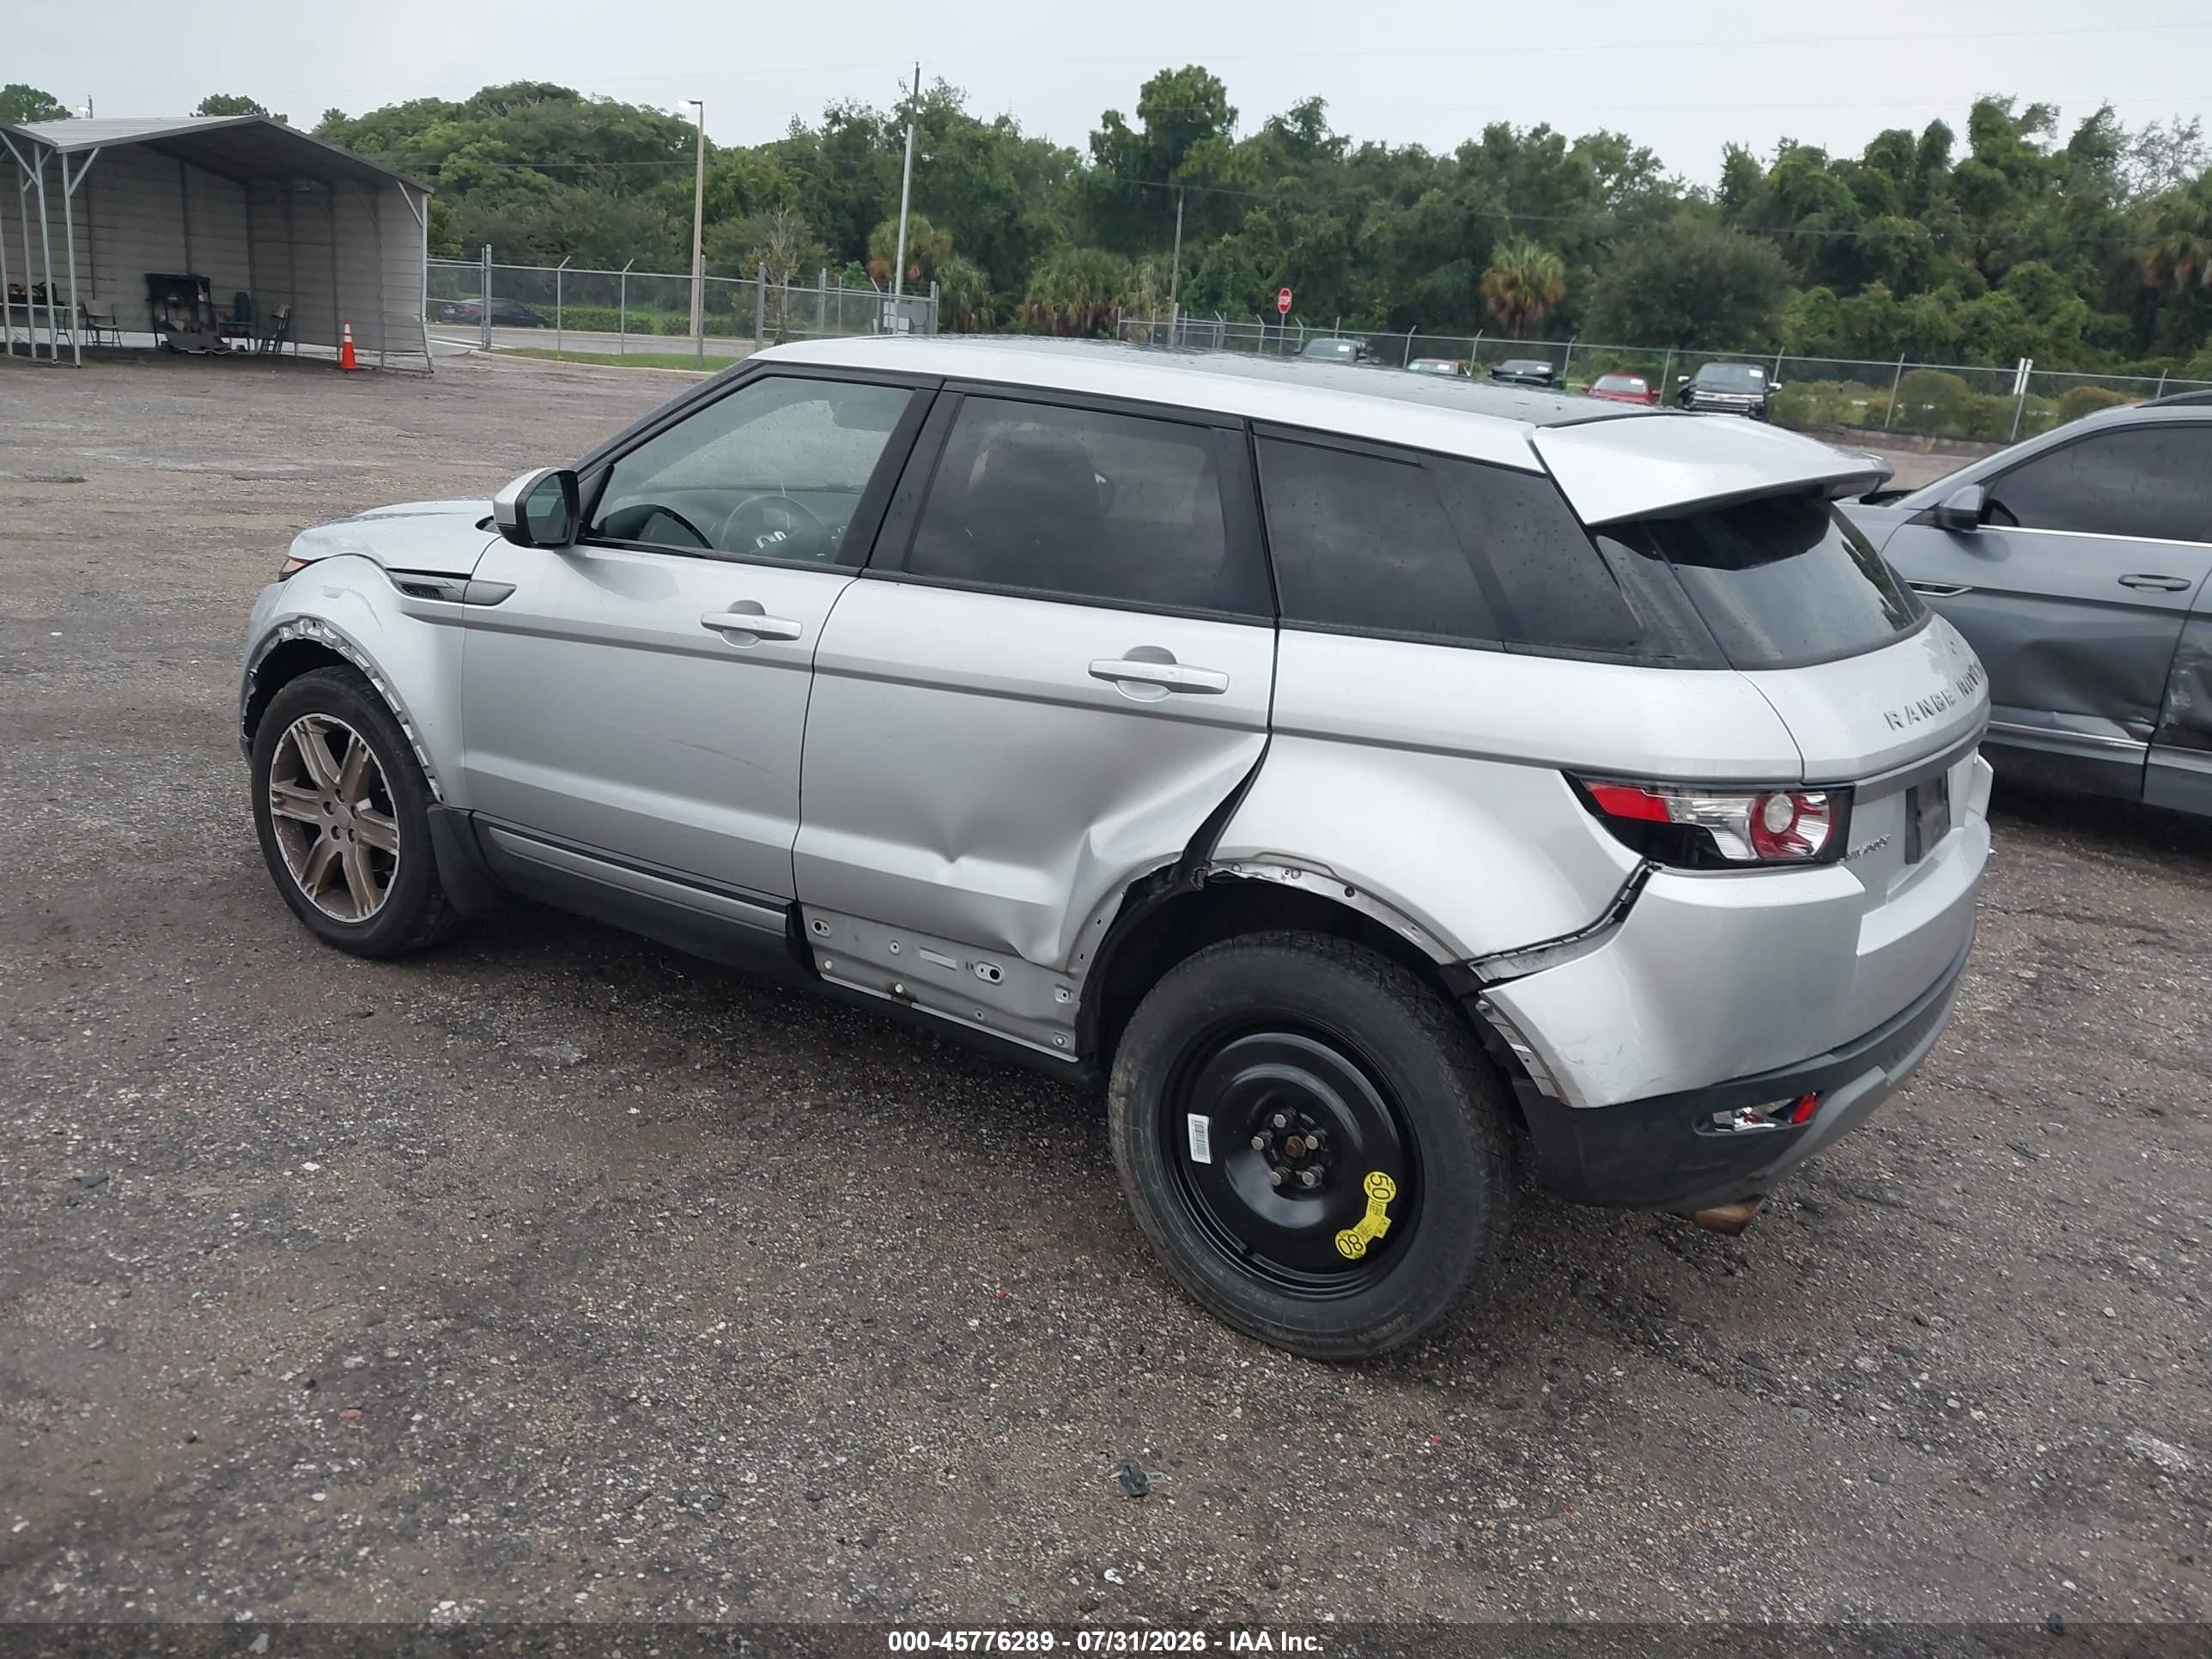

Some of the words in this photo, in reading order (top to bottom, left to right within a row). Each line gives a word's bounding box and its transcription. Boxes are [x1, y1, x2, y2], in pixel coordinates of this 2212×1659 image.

[1883, 690, 1956, 732] RANGE
[1370, 1174, 1391, 1200] 50
[1338, 1234, 1364, 1255] 80
